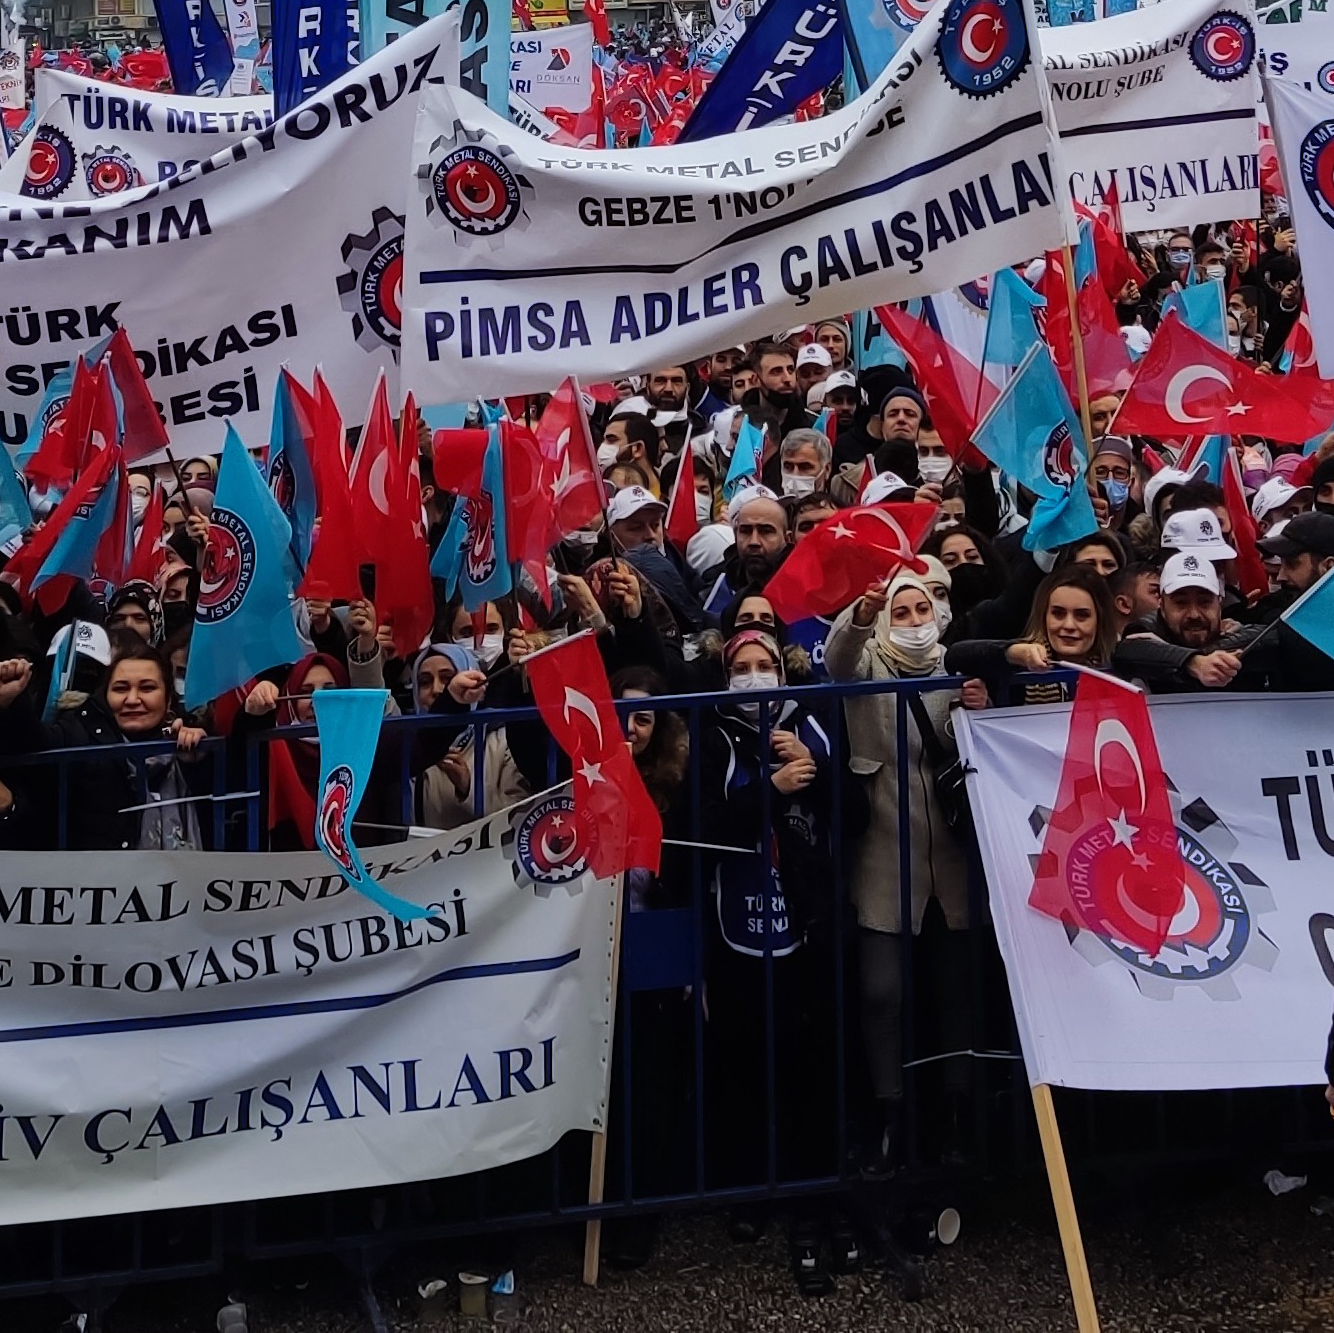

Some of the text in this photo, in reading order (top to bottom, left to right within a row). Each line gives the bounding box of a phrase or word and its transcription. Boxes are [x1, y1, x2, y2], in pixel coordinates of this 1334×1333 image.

[536, 73, 581, 85] DOKSAN
[973, 55, 1016, 87] 1952
[1050, 64, 1166, 103] NOLU ŞUBE
[436, 149, 518, 202] TÜRK METAL SENDİKASI
[659, 156, 766, 180] METAL
[1301, 142, 1321, 182] TÜRK
[577, 195, 696, 227] GEBZE
[362, 272, 380, 315] TÜRK
[424, 296, 592, 362] PİMSA
[609, 261, 765, 345] ADLER
[215, 512, 253, 620] METAL SENDİKASI
[518, 799, 559, 860] TÜRK METAL
[32, 935, 277, 993] DİLOVASI
[294, 887, 471, 976] ŞUBESİ
[83, 1037, 558, 1165] ÇALIŞANLARI
